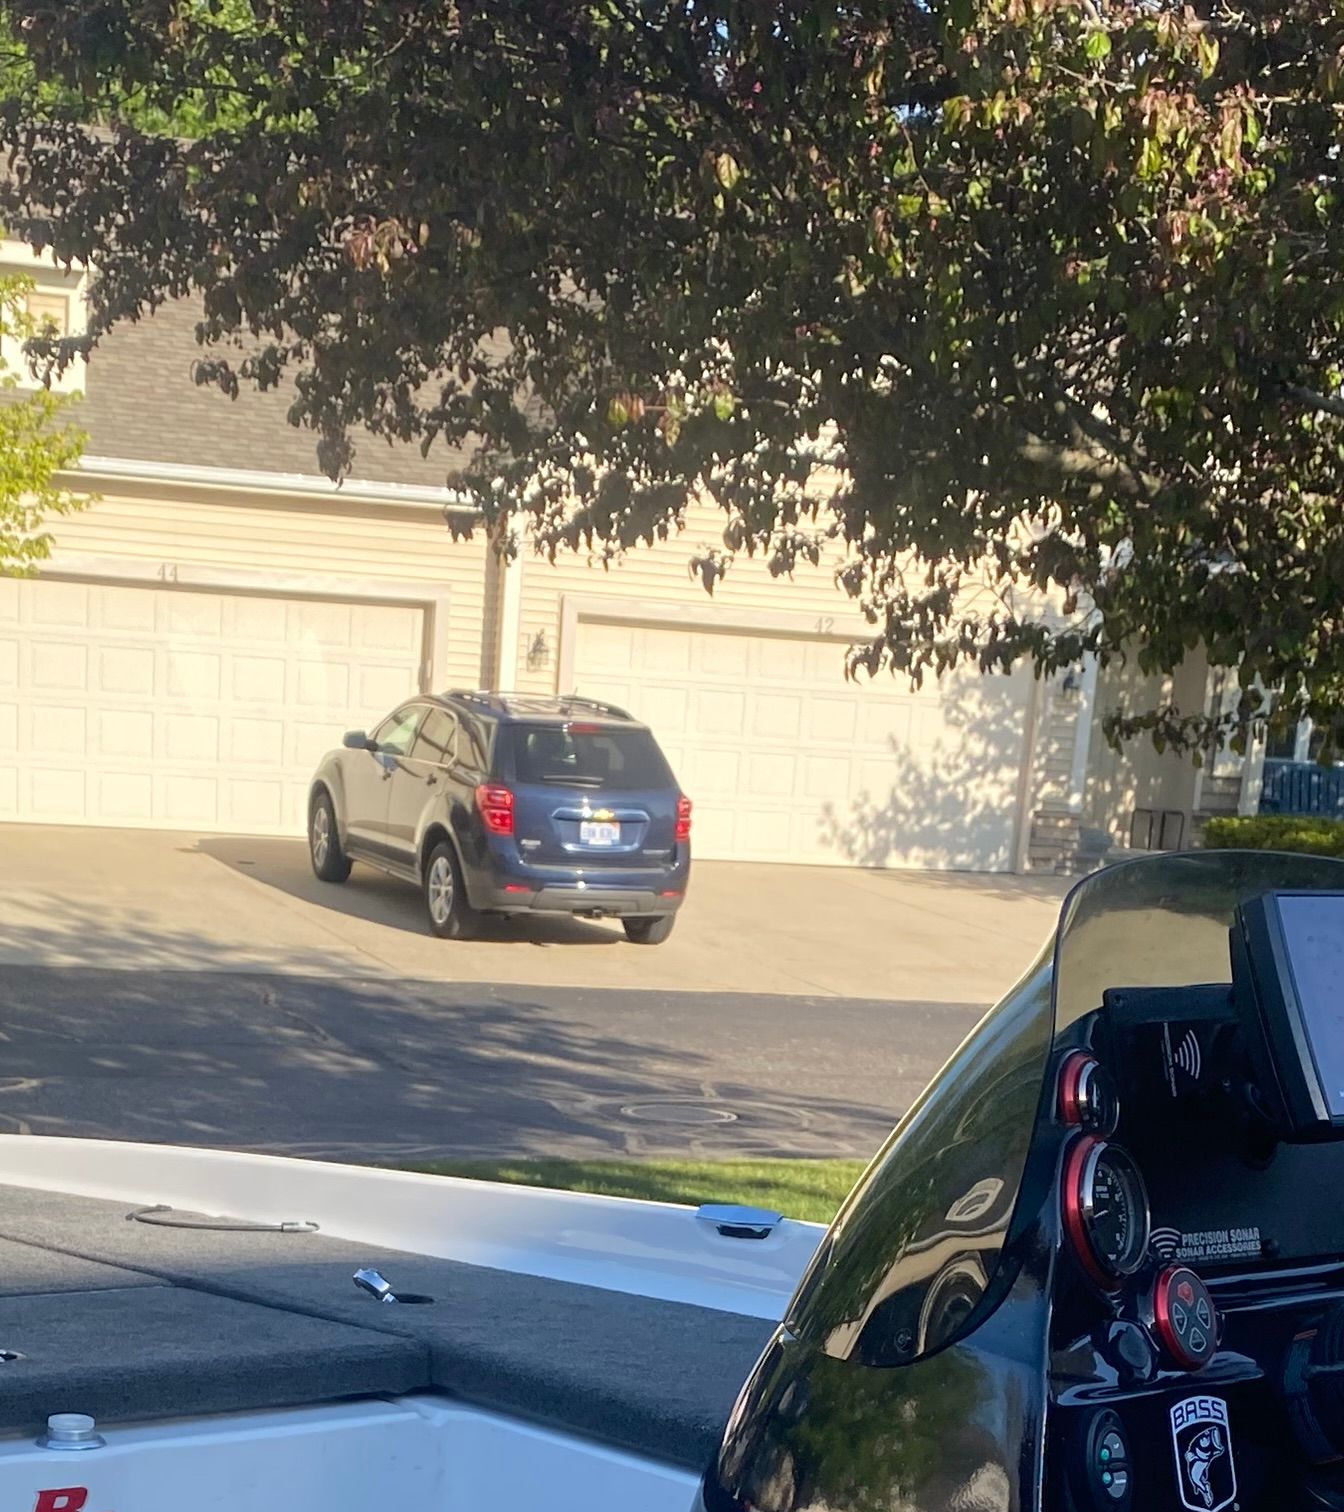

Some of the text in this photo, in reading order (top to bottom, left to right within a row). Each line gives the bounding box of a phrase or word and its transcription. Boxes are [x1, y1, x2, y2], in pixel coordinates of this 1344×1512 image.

[157, 562, 178, 582] 44
[814, 616, 834, 633] 42
[1181, 1227, 1260, 1247] PRECISION SONAR
[1175, 1246, 1204, 1258] SONAR
[1206, 1240, 1261, 1256] ACCESSORIES
[1173, 1399, 1225, 1430] BASS
